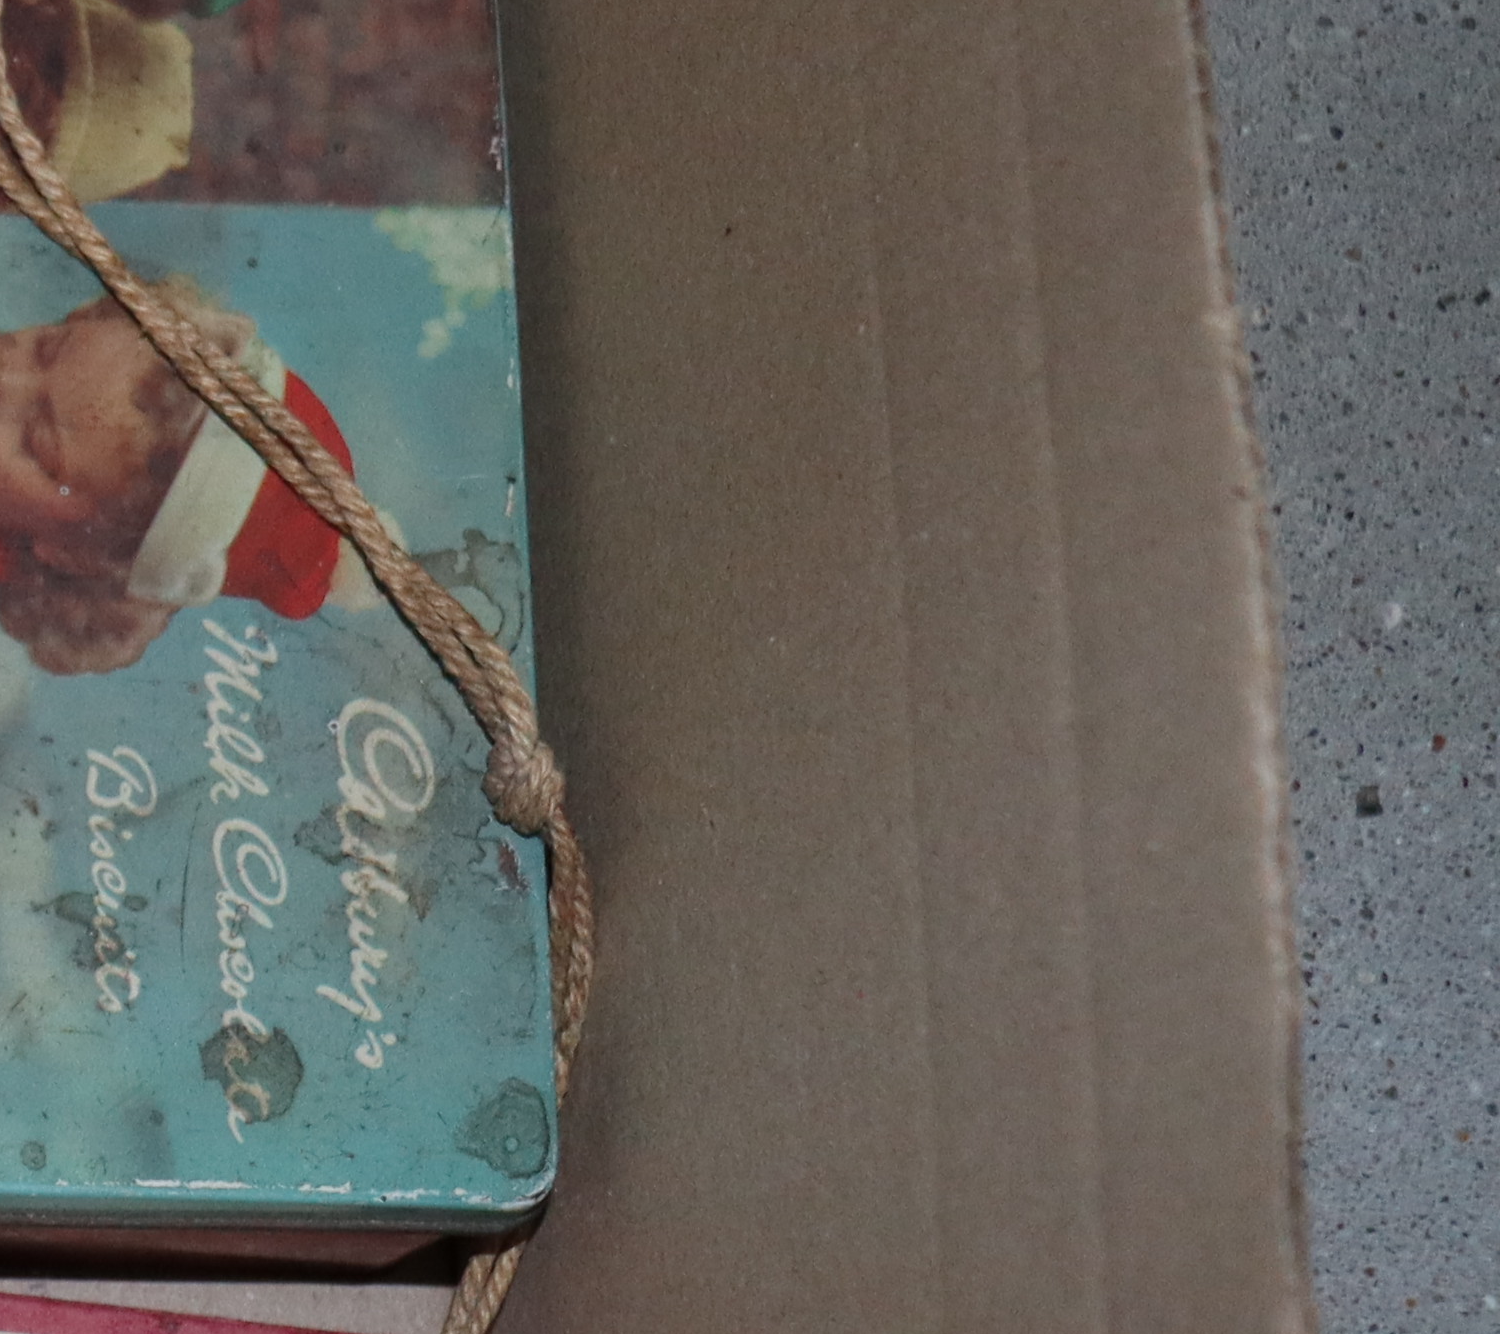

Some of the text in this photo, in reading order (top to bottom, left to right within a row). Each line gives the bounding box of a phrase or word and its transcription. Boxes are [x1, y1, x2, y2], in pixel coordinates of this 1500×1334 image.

[85, 744, 158, 1014] Biscuits
[204, 618, 289, 1143] Milk Chocolate
[316, 698, 435, 1069] Cadbury's
